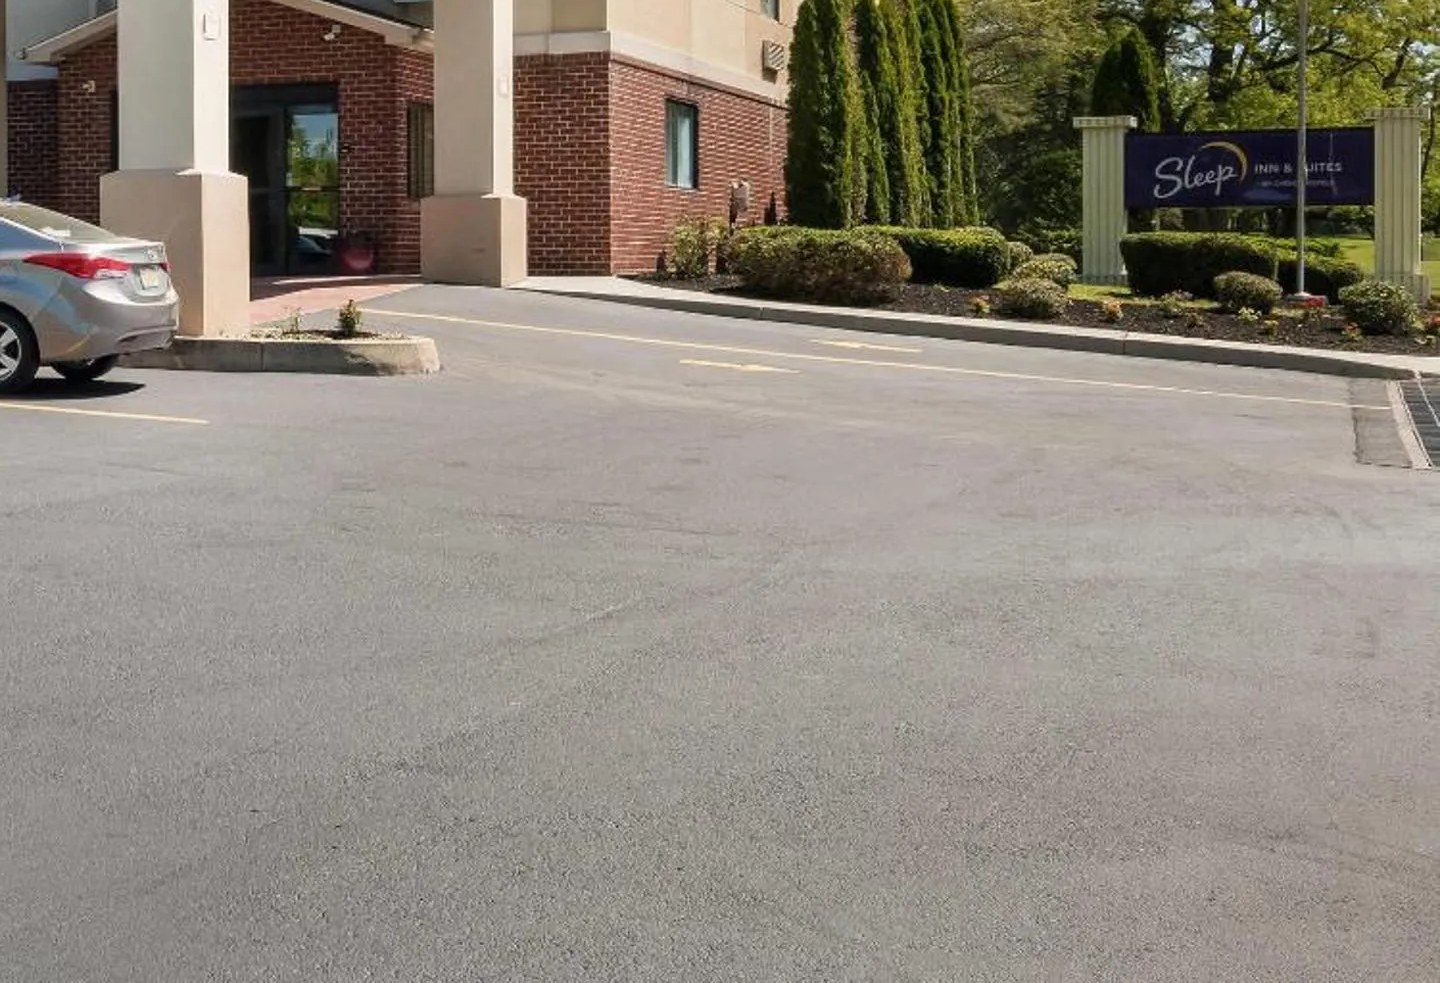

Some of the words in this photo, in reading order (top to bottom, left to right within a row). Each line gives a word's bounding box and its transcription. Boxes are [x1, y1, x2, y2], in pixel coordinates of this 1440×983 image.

[1153, 155, 1238, 200] Sleep
[1254, 164, 1279, 173] INN
[1301, 162, 1342, 173] UITES
